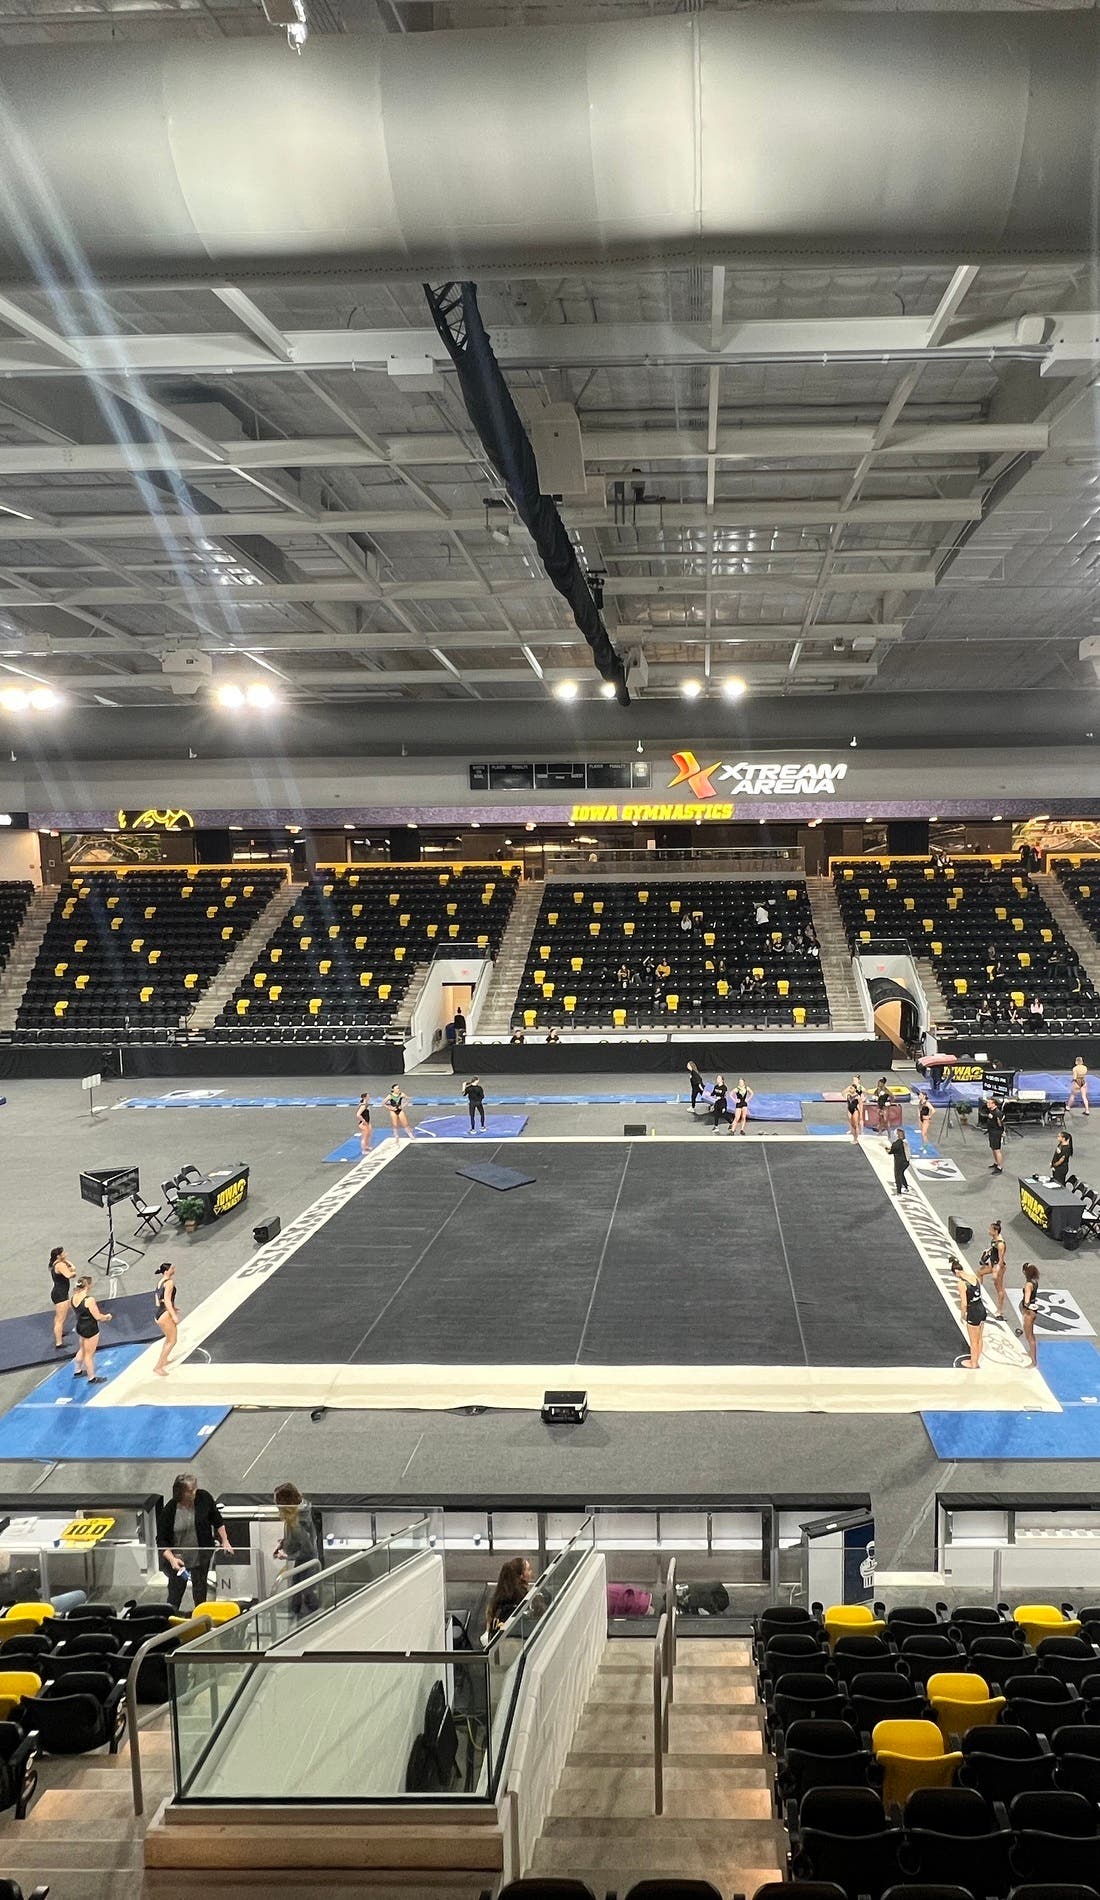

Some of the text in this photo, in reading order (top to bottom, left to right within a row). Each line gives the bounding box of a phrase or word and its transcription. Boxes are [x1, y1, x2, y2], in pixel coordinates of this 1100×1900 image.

[717, 762, 848, 780] XTREAM
[730, 779, 836, 795] ARENA
[570, 803, 735, 821] IOWA GYMNASTICS
[237, 1191, 351, 1279] HAWKEYES
[66, 1524, 108, 1536] 10.0
